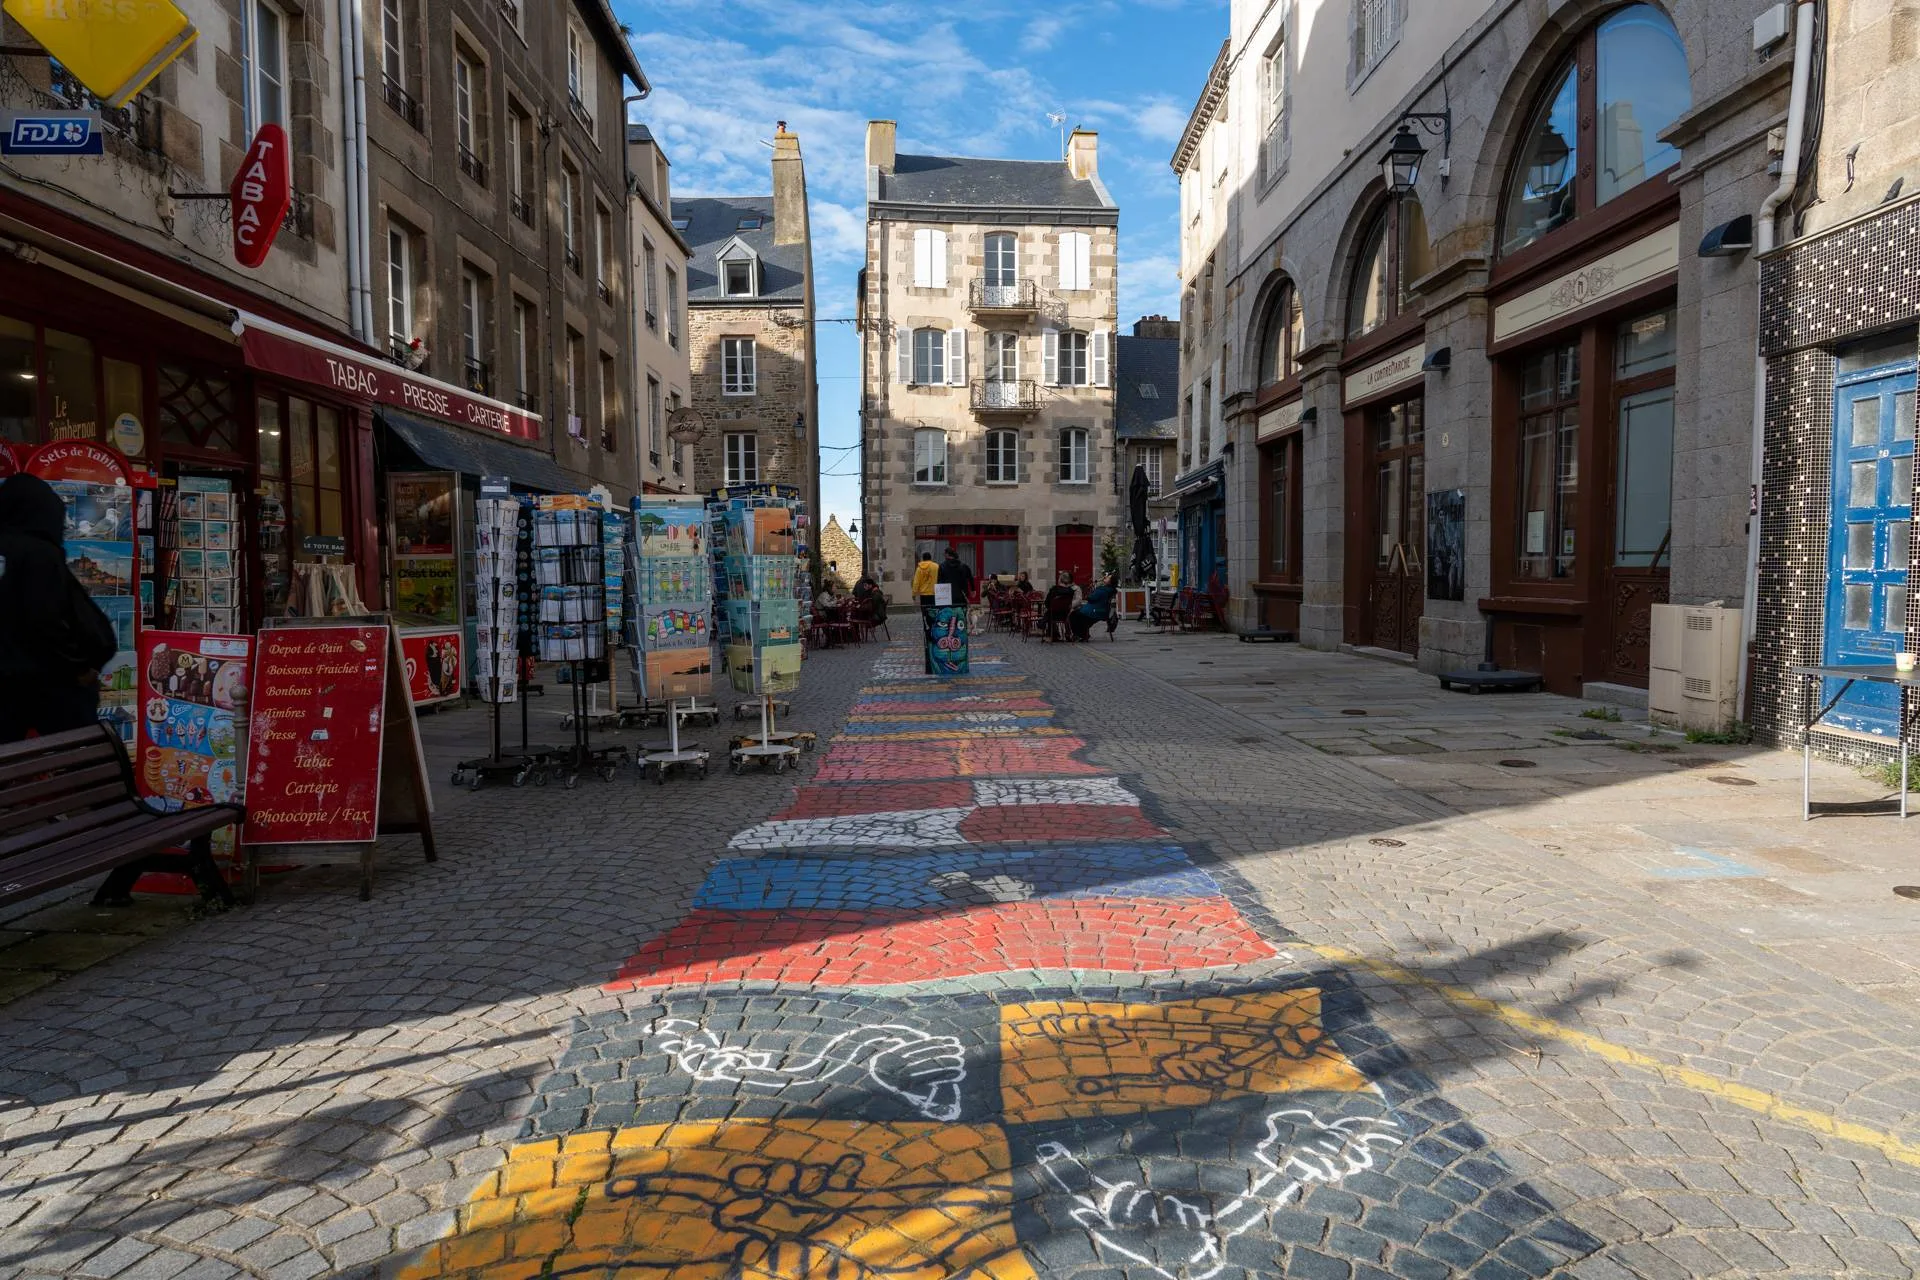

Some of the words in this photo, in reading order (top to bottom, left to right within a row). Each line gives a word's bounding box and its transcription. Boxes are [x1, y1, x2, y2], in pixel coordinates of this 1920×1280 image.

[16, 123, 61, 142] FDJ
[237, 140, 273, 245] TABAC
[326, 359, 378, 396] TABAC
[402, 383, 450, 416] PRESSE
[467, 403, 510, 433] CARTERIE
[55, 395, 67, 418] Le
[39, 448, 68, 467] Sets
[70, 446, 83, 457] de
[86, 446, 119, 472] Table
[269, 644, 302, 657] Depot
[303, 642, 315, 654] de
[318, 643, 343, 654] Pain
[267, 664, 313, 675] Boissons
[265, 684, 313, 697] Bonbons
[264, 706, 306, 719] Timbres
[263, 729, 297, 740] Presse
[294, 754, 335, 768] Tabac
[285, 780, 339, 796] Carterie
[252, 808, 328, 826] Photocopie
[342, 807, 371, 824] Fax
